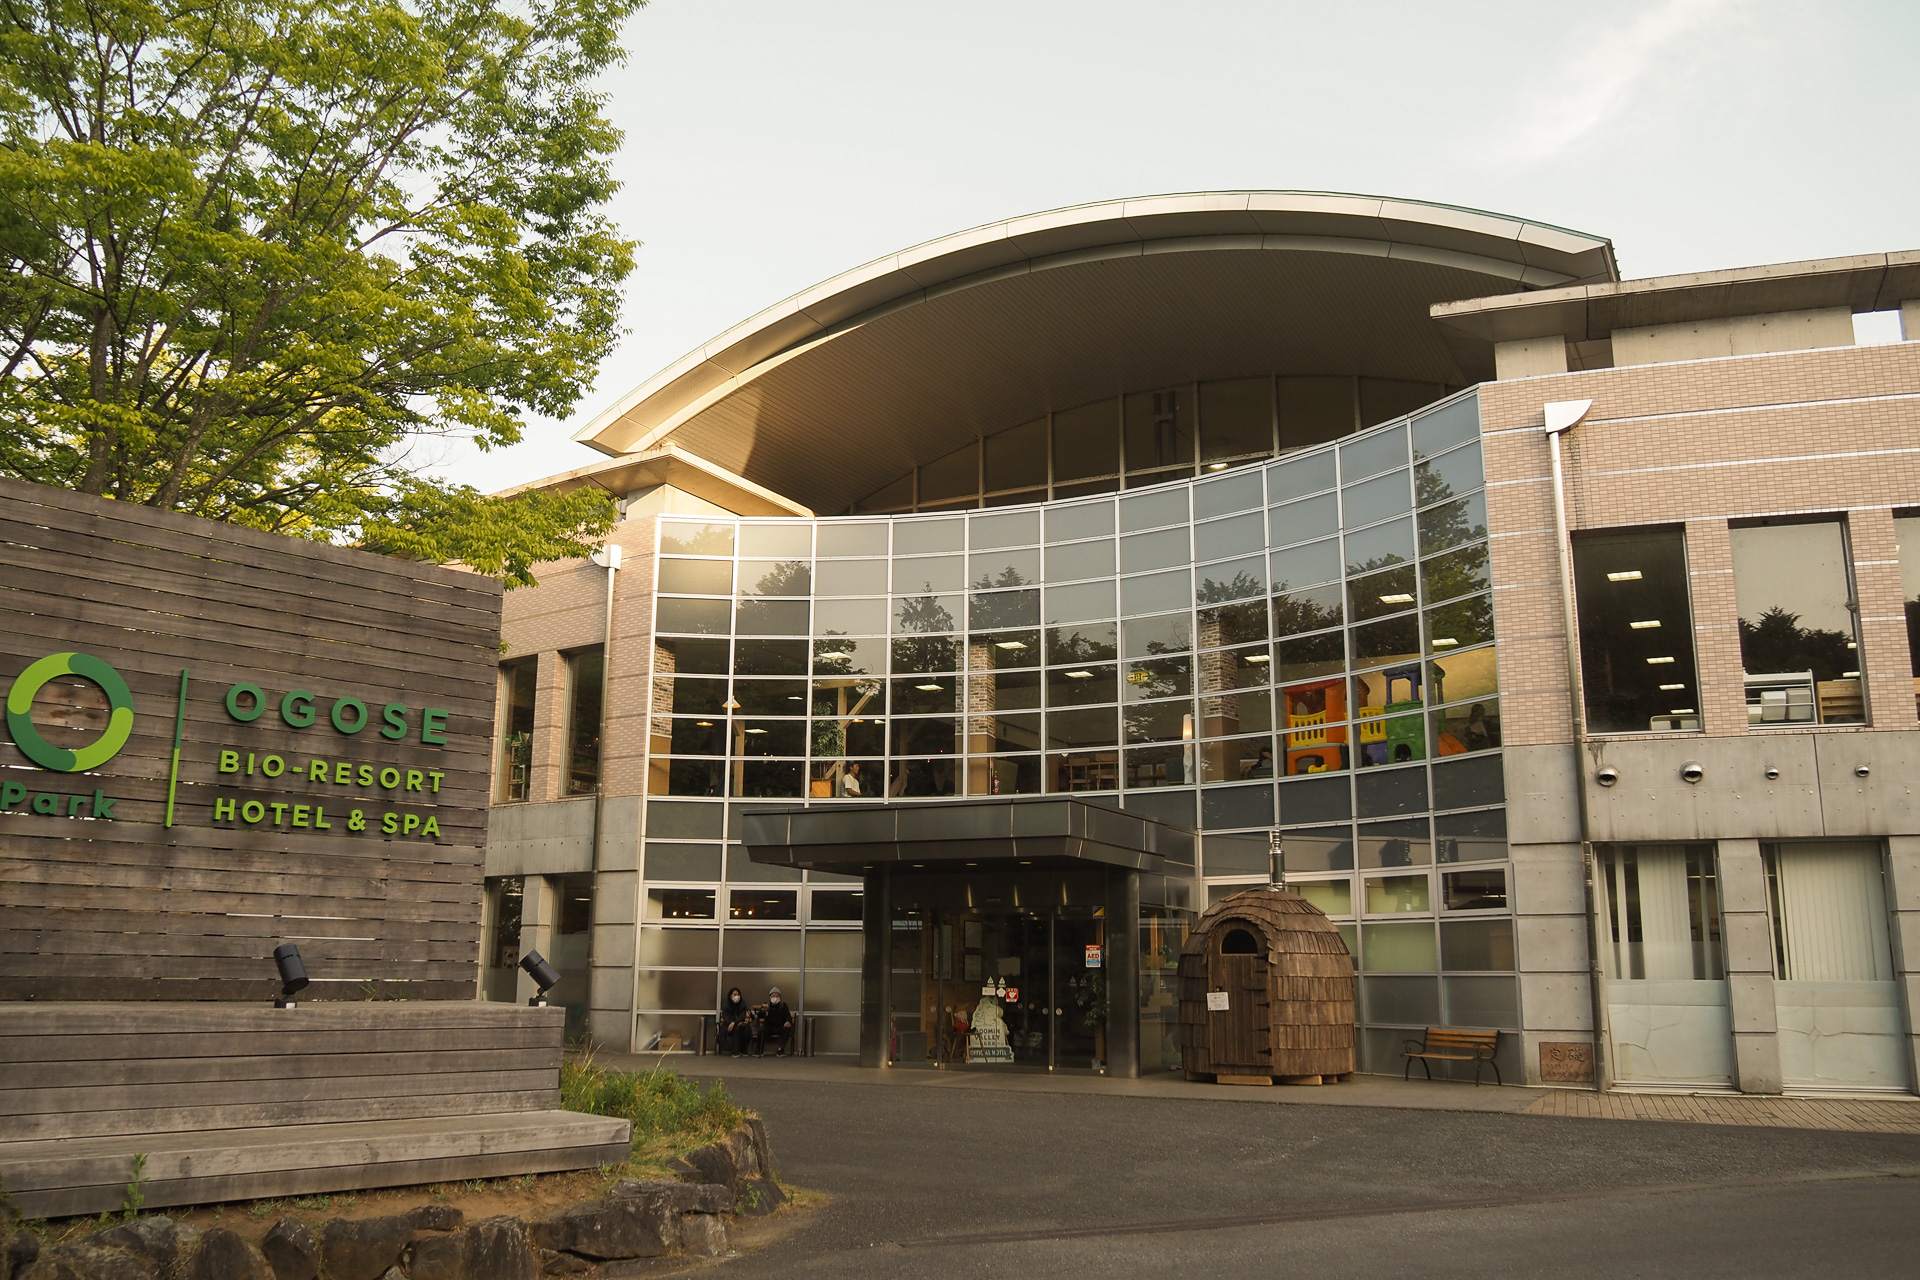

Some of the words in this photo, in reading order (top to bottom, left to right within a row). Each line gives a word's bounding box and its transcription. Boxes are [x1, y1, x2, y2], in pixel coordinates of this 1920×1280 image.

[224, 683, 450, 746] OGOSE
[217, 749, 446, 794] BIO-RESORT
[0, 780, 118, 819] Park
[213, 796, 332, 831] HOTEL
[347, 808, 367, 833] &
[381, 811, 441, 838] SPA
